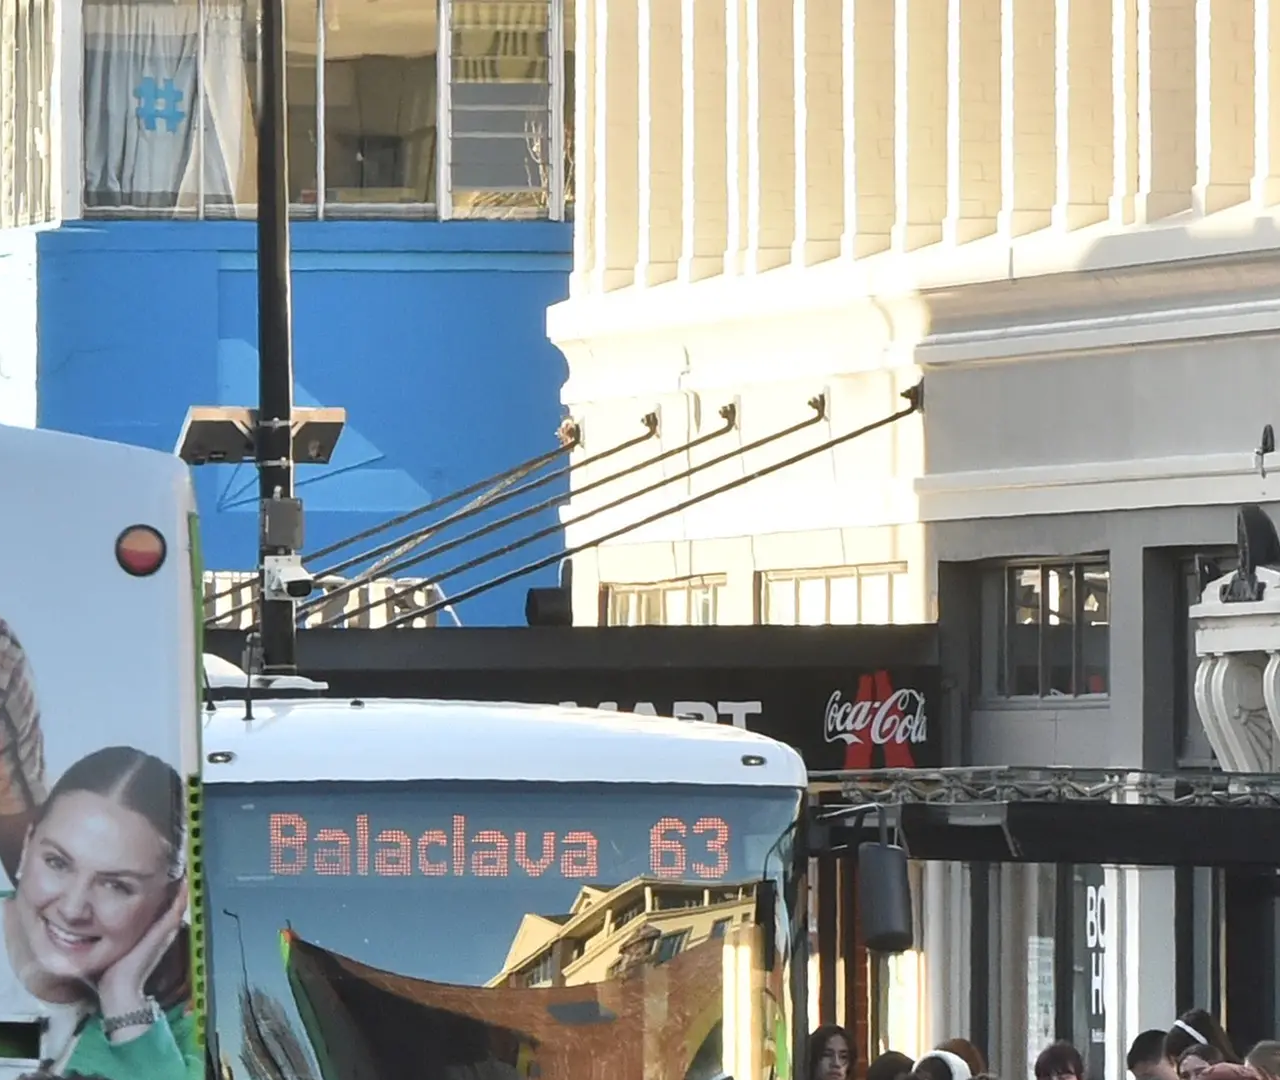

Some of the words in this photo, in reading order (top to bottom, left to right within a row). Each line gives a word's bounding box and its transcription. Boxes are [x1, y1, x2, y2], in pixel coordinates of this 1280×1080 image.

[824, 688, 927, 746] Coca-Cola
[268, 813, 599, 877] Balaclava
[649, 817, 730, 878] 63
